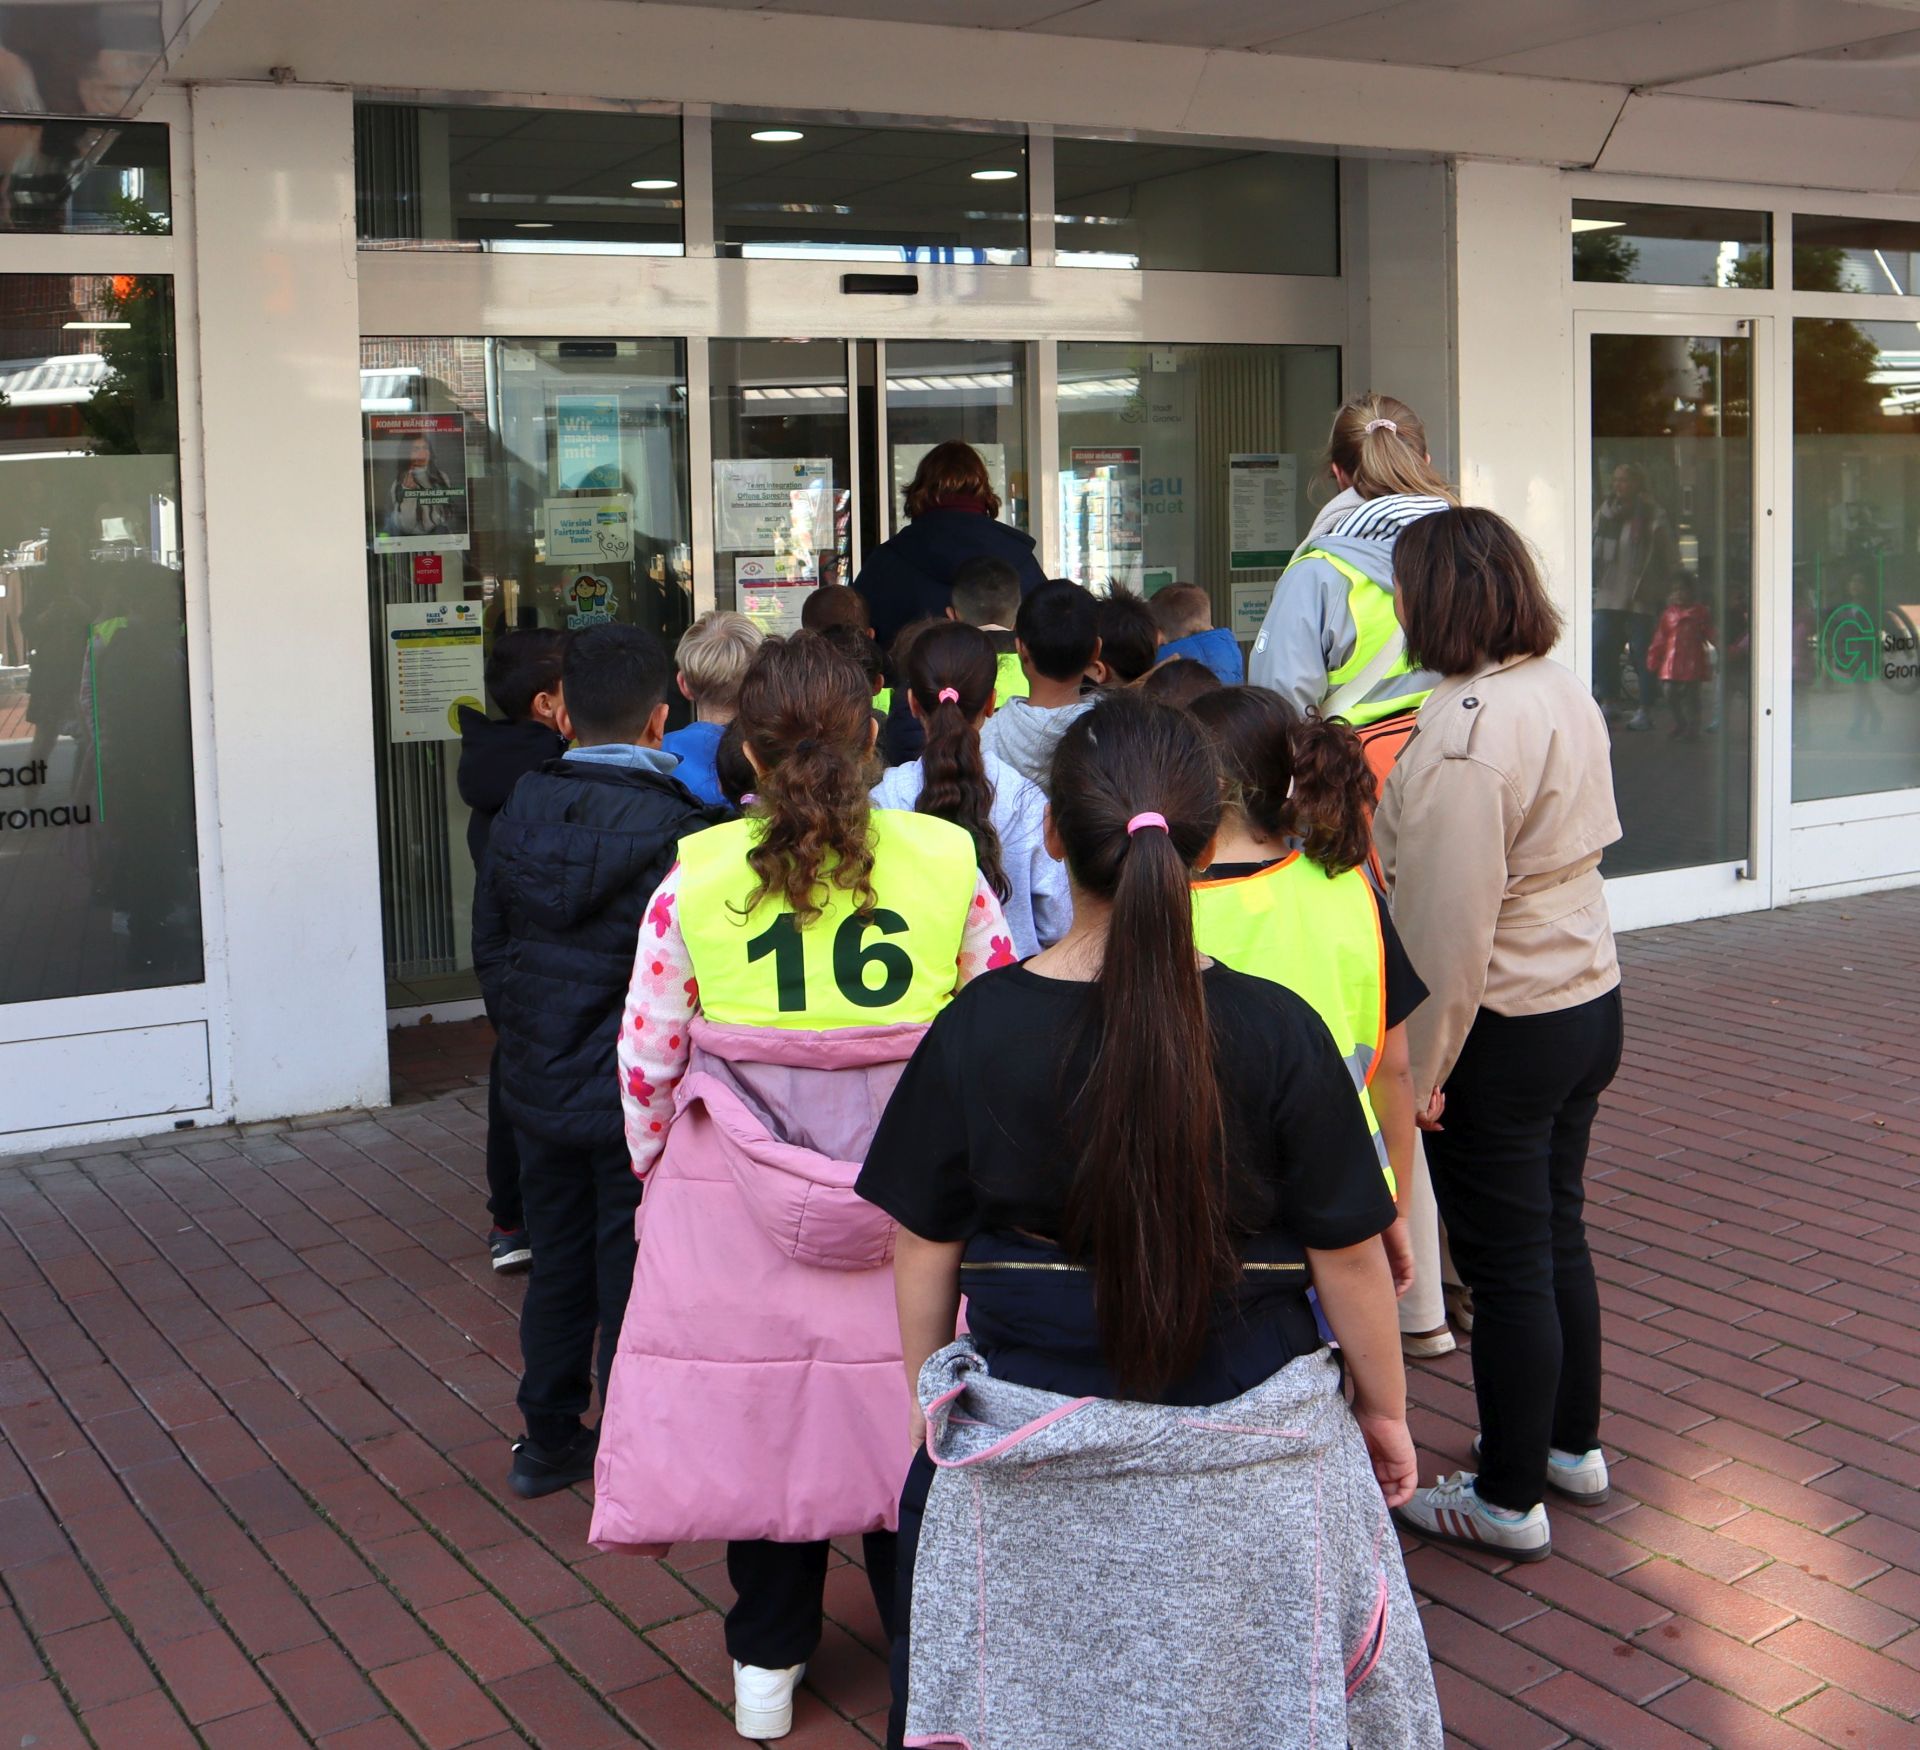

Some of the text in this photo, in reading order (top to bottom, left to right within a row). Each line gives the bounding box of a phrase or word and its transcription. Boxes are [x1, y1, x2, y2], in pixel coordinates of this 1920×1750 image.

[376, 418, 438, 428] KOMM WÄHLEN!
[565, 417, 592, 431] Wir
[564, 433, 609, 443] machen
[565, 444, 596, 459] mit!
[560, 519, 574, 527] Wir
[575, 518, 592, 526] sind
[554, 528, 592, 536] Fairtrade-
[570, 535, 592, 543] Town!
[1885, 663, 1920, 680] Gron
[0, 760, 48, 787] adt
[747, 908, 913, 1012] 16
